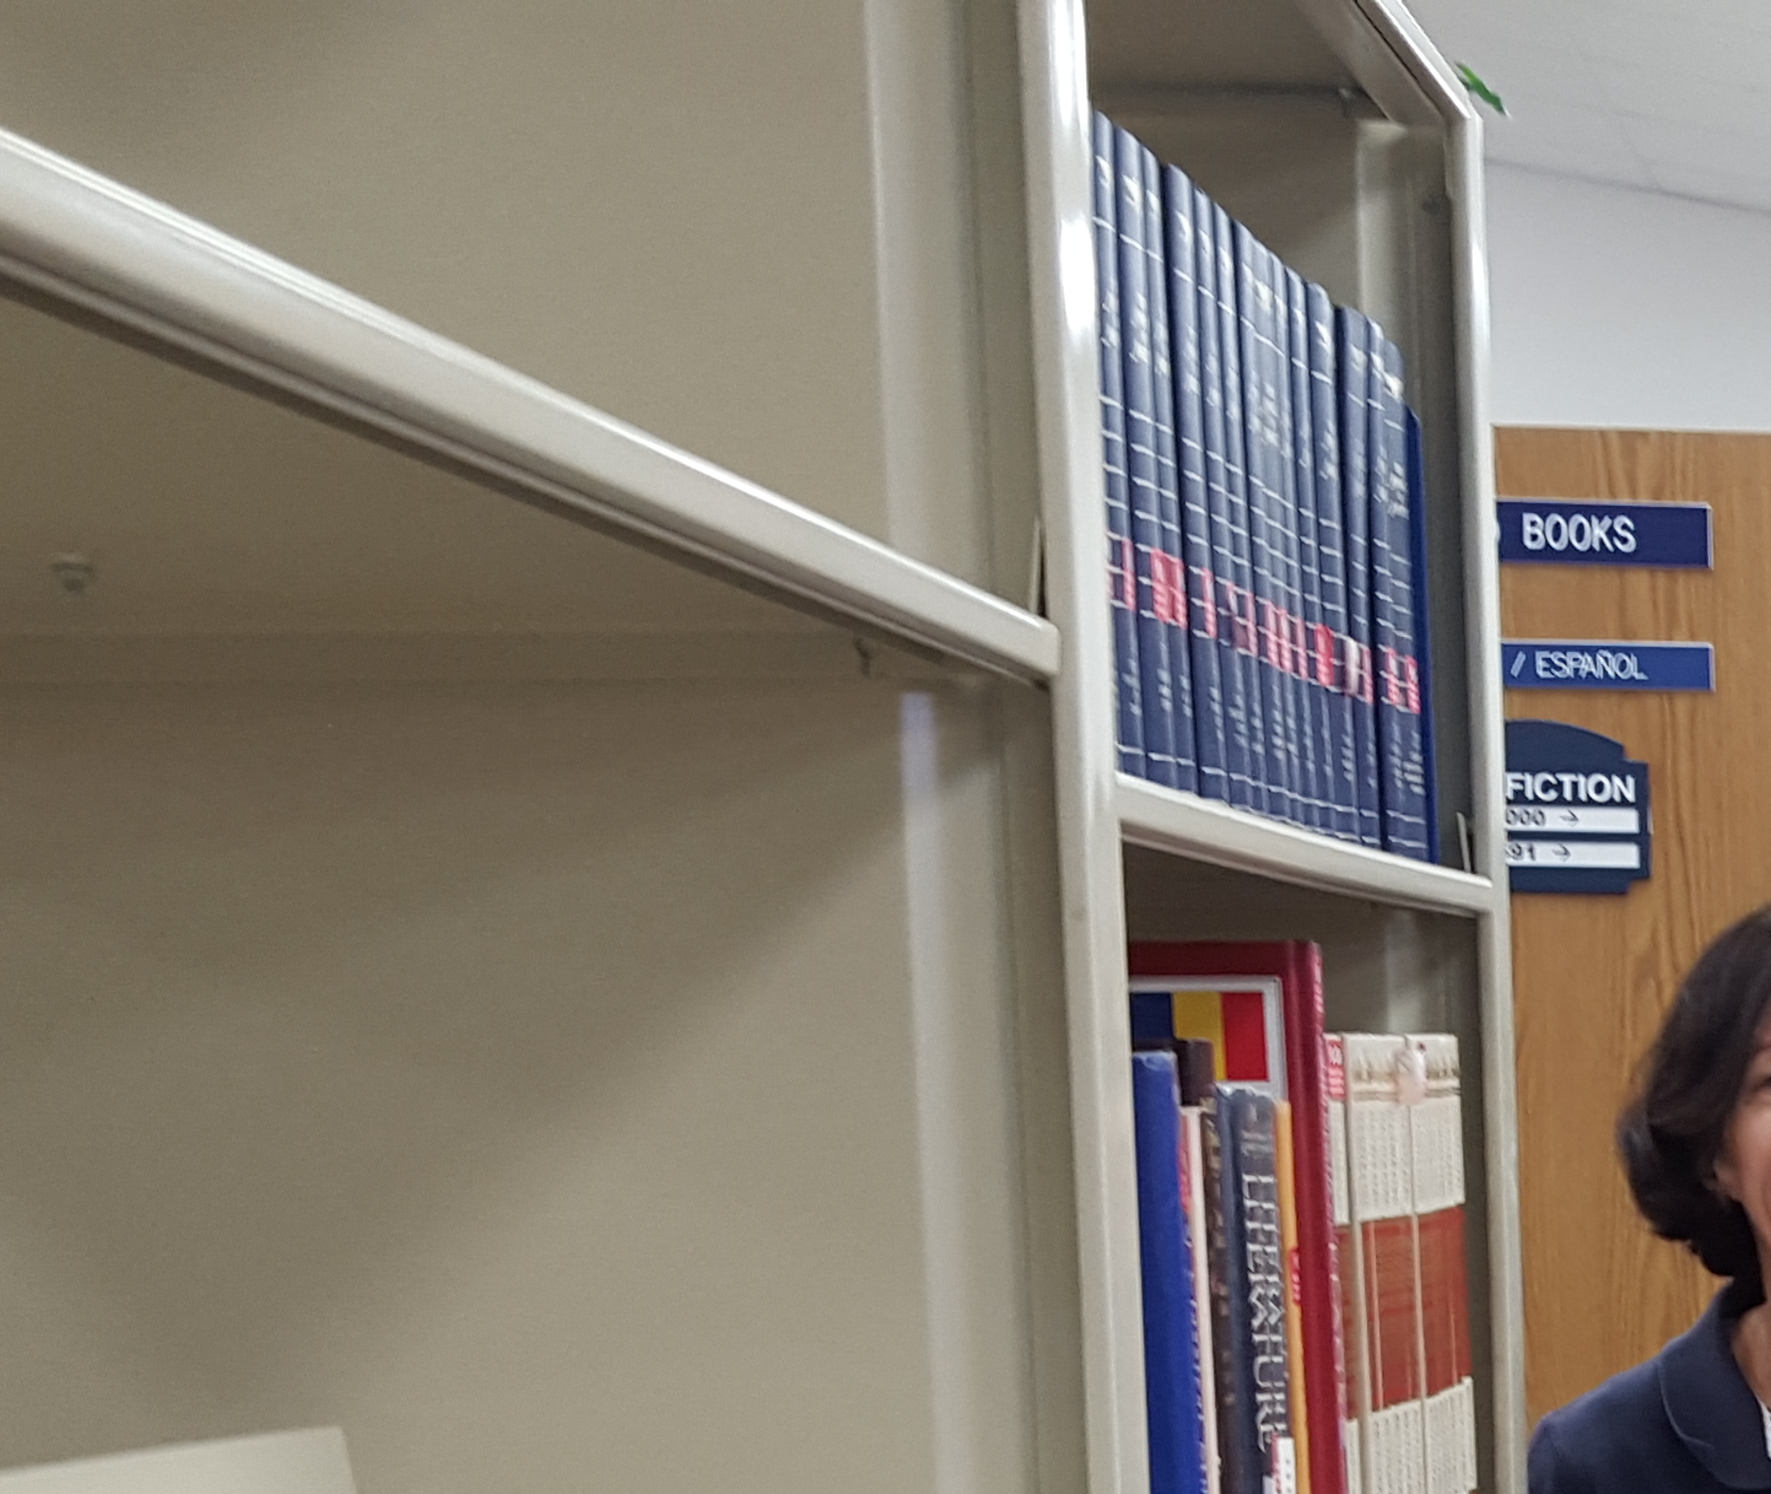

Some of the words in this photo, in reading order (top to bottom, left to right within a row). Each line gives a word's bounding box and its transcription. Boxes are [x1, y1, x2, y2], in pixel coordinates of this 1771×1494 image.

[1522, 512, 1637, 553] BOOKS
[1535, 650, 1648, 681] ESPAÑOL
[1505, 772, 1636, 803] FICTION
[1505, 844, 1537, 862] 91
